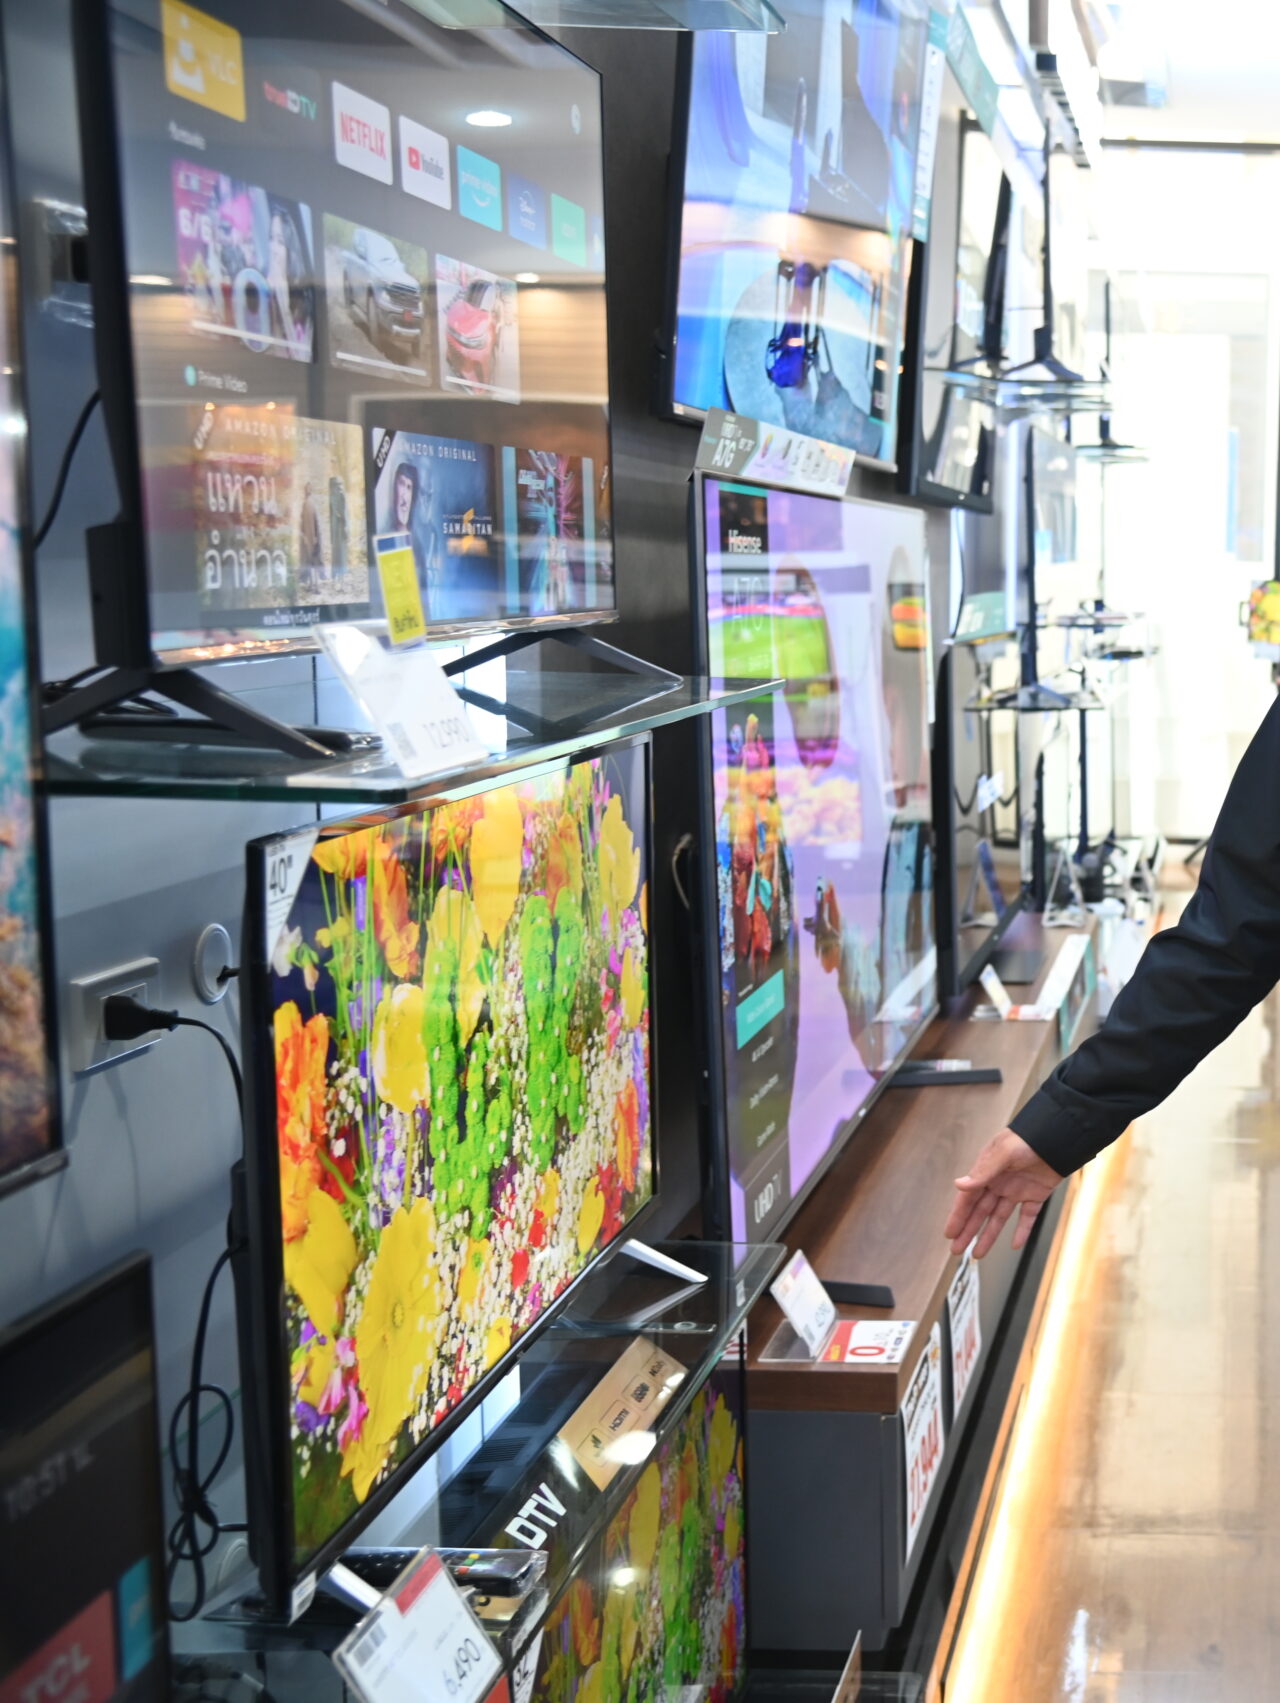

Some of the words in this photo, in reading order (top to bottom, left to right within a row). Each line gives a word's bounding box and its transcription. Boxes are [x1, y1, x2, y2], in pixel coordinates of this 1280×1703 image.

[340, 111, 387, 160] NETFLIX
[224, 418, 277, 439] AMAZON
[376, 435, 391, 468] UHD
[439, 446, 477, 462] ORIGINAL
[442, 522, 493, 536] SAMARITAN
[755, 1183, 774, 1223] UHD
[608, 1408, 630, 1432] HDMI
[504, 1481, 567, 1550] DTV
